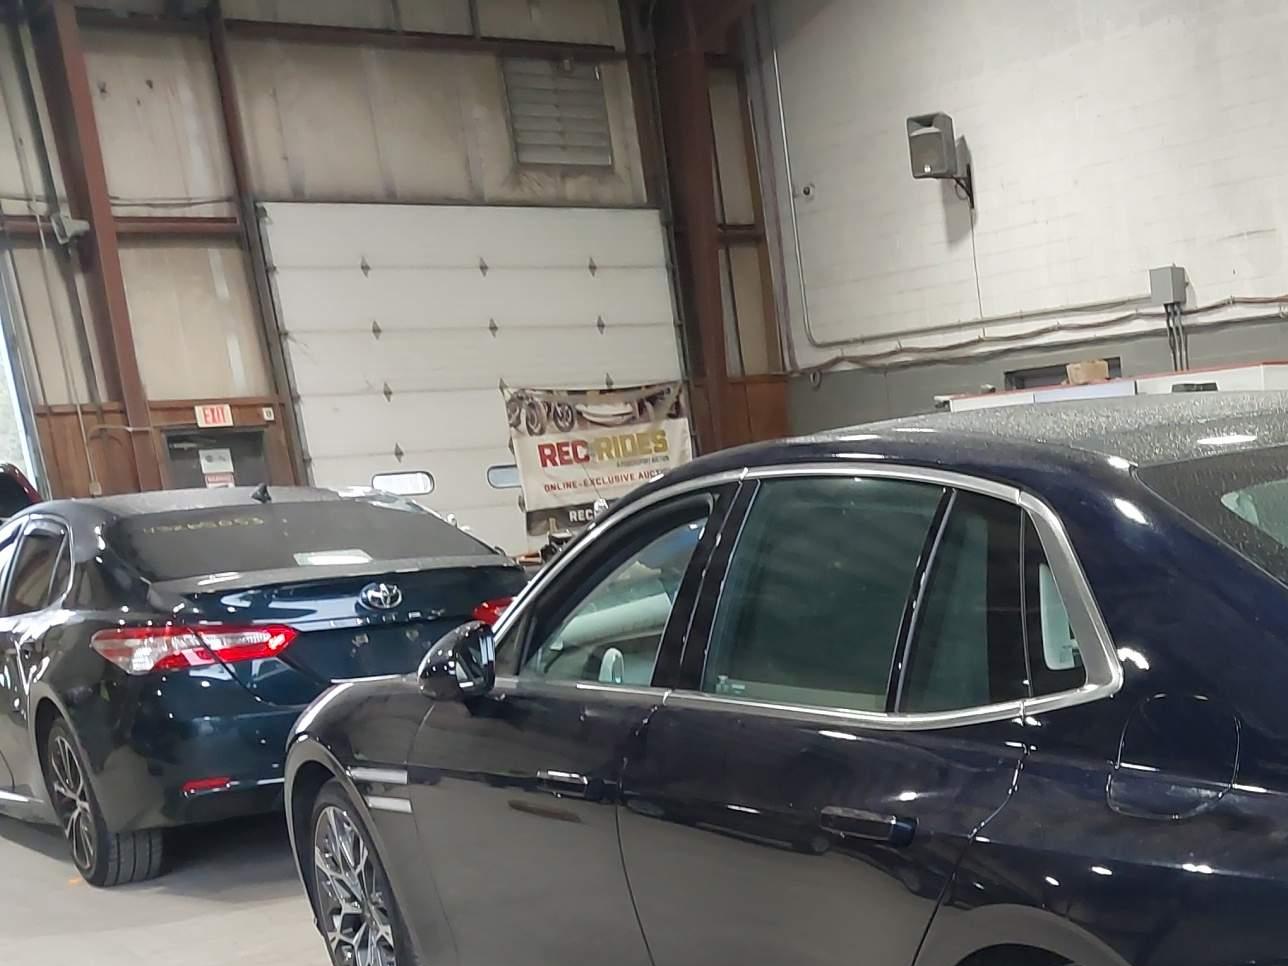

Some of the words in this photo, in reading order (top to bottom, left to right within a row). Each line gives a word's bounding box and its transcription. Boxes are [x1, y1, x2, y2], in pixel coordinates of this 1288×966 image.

[203, 407, 226, 424] EXIT
[538, 440, 590, 468] REC
[594, 430, 668, 461] RIDES
[544, 472, 634, 493] ONLINE-EXCLUSIVE
